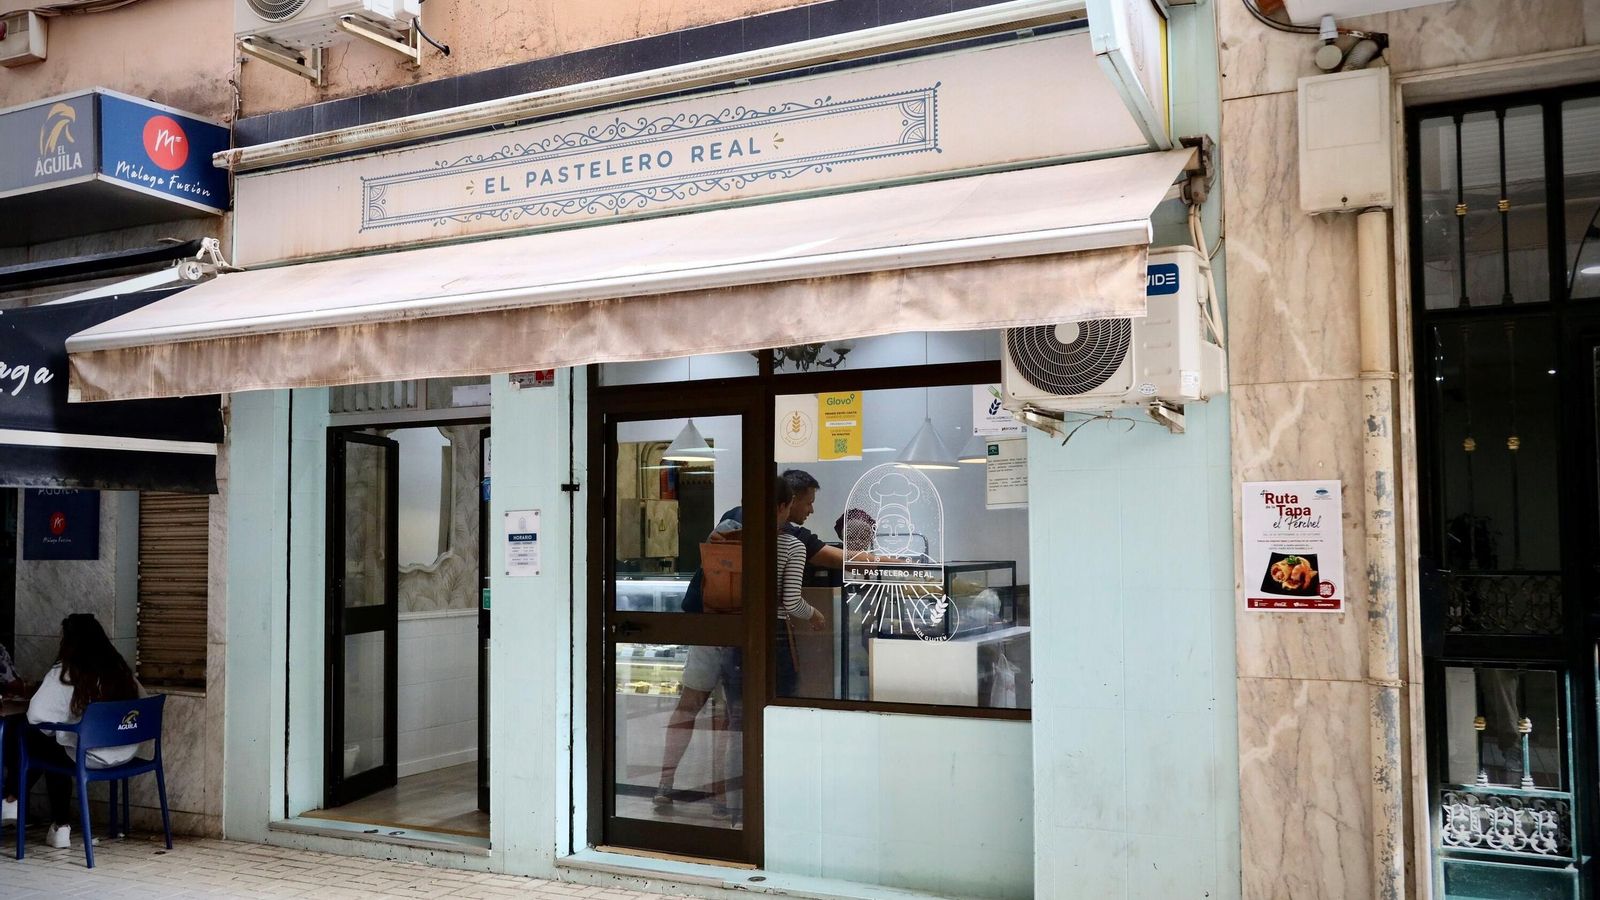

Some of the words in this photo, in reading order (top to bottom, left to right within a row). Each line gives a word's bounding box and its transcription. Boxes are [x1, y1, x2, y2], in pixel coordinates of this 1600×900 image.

[57, 145, 66, 155] EL
[485, 176, 511, 194] EL
[525, 150, 673, 188] PASTELERO
[691, 137, 761, 163] REAL
[115, 160, 165, 188] Málaga
[826, 396, 851, 405] Glovo
[1265, 493, 1298, 504] Ruta
[1276, 505, 1311, 518] Tapa
[851, 568, 861, 576] EL
[864, 569, 910, 578] PASTELERO
